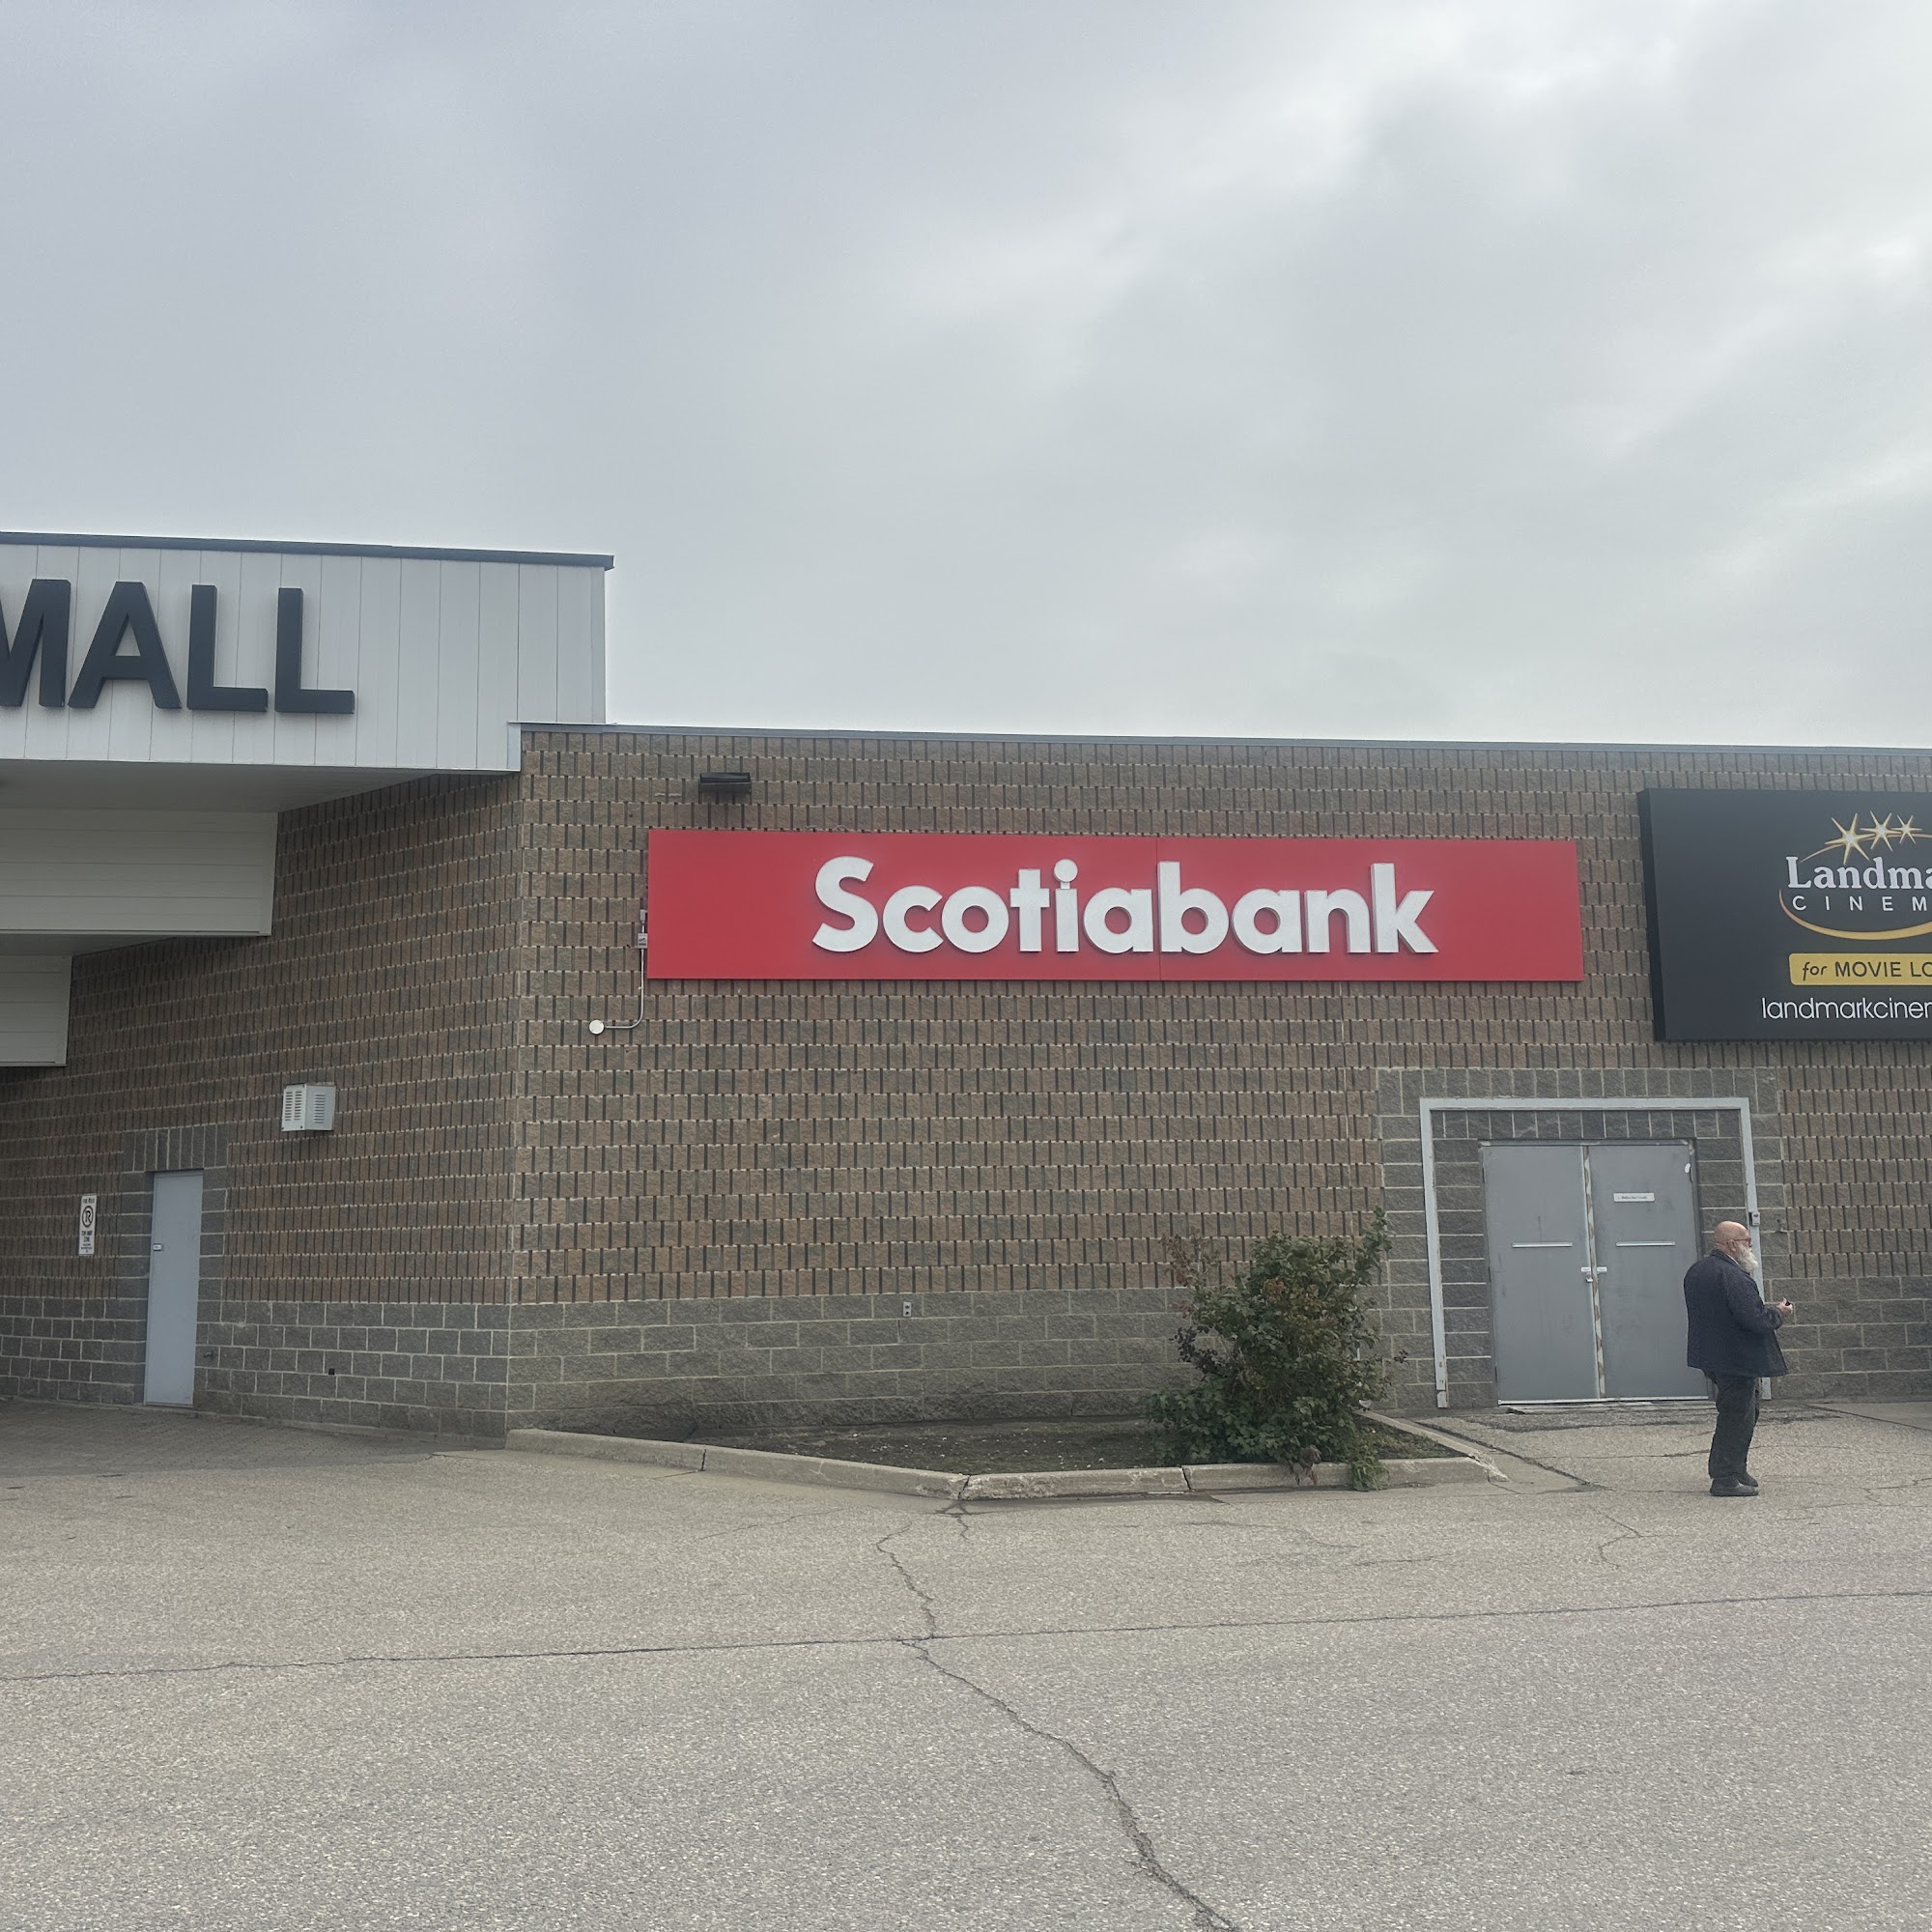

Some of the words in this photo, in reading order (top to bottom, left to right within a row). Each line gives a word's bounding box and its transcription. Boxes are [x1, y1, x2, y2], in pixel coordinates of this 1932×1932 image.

[0, 578, 355, 714] MALL
[812, 856, 1438, 954] Scotiabank
[1792, 895, 1927, 911] CINEM
[1802, 961, 1828, 981] for
[1834, 961, 1902, 978] MOVIE
